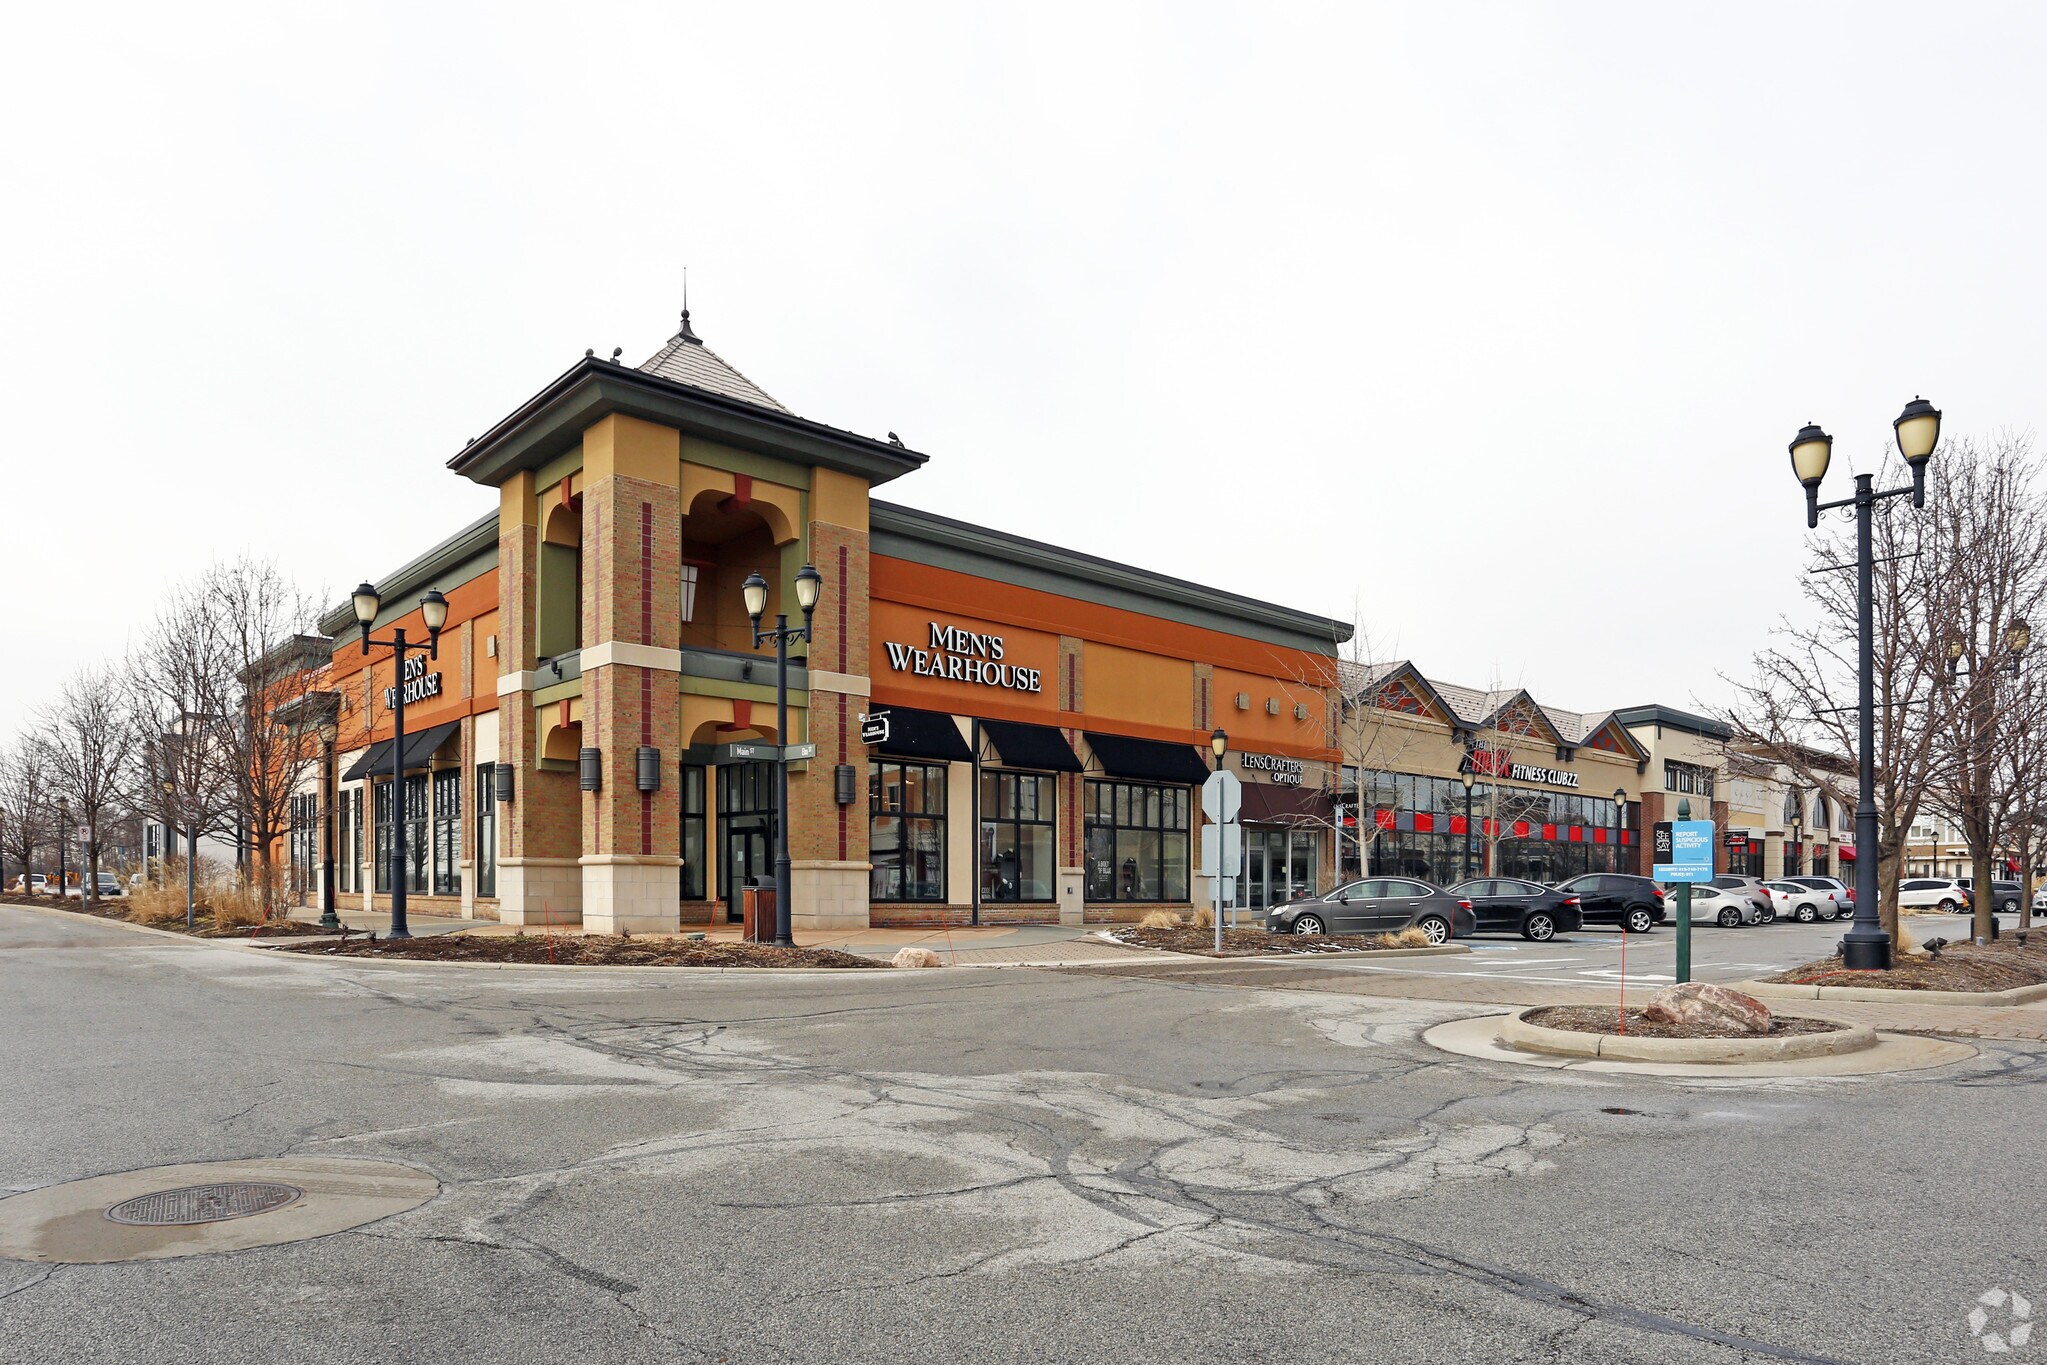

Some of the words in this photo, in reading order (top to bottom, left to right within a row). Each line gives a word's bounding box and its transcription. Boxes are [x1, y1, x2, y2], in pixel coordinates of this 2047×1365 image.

[929, 622, 1004, 660] MEN'S
[404, 654, 423, 681] EN'S
[886, 641, 1042, 692] WEARHOUSE
[384, 672, 438, 708] WERHOUSE
[736, 747, 750, 756] Main
[1273, 772, 1303, 784] OPTIQUE
[1512, 763, 1547, 782] FITNESS
[1547, 769, 1579, 787] CLUBZZ
